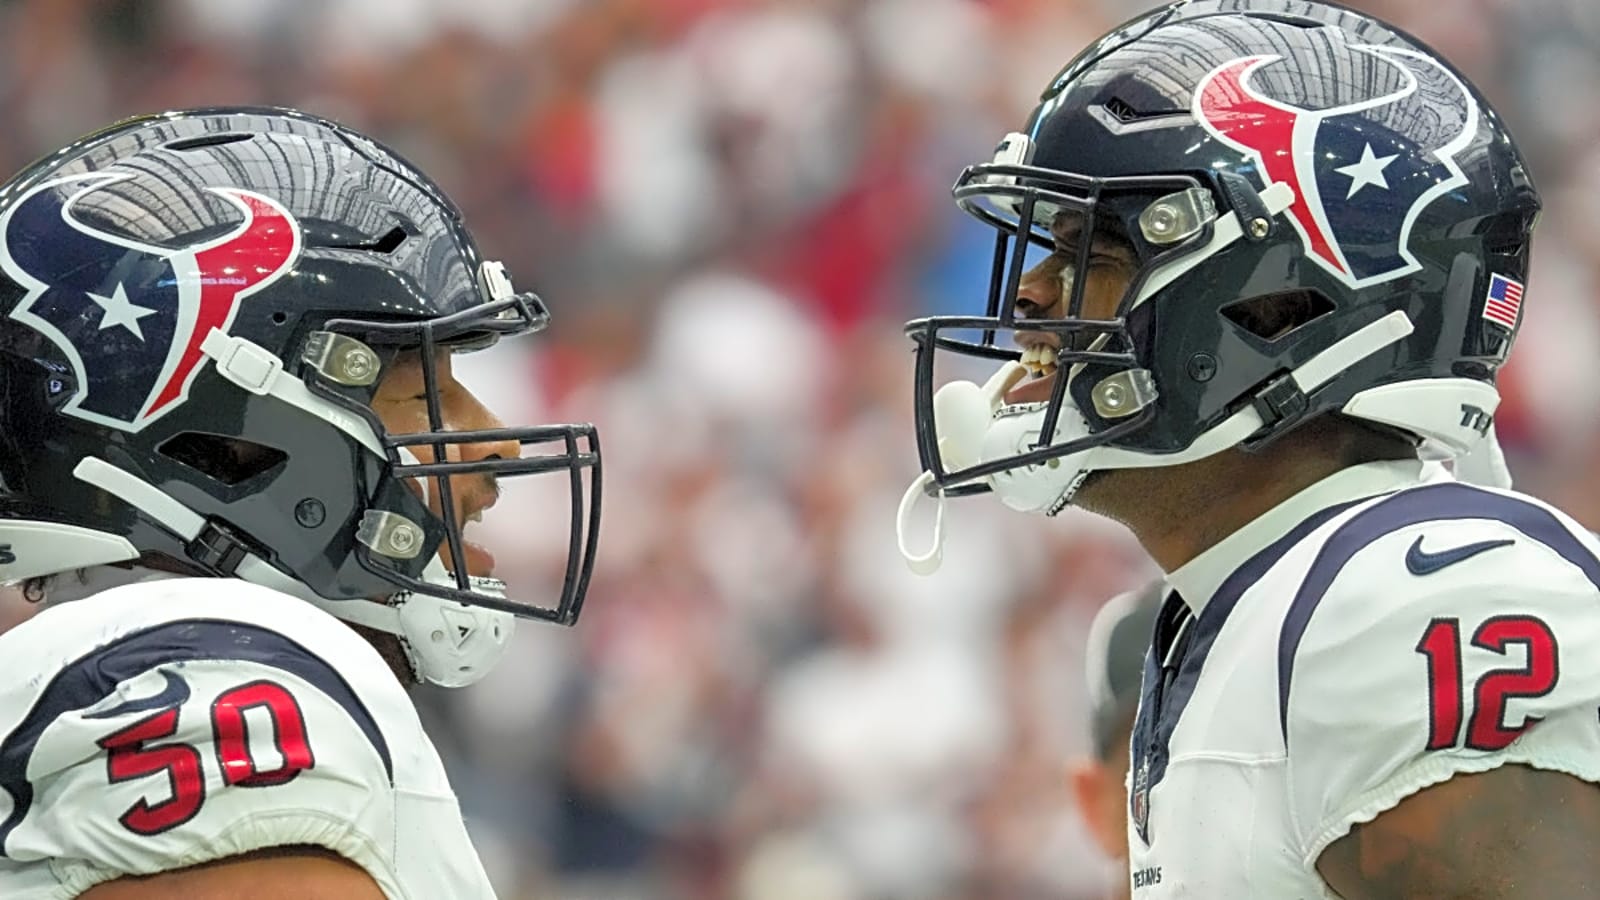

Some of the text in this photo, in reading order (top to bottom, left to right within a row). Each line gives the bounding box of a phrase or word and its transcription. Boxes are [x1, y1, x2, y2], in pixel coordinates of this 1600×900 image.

[1415, 614, 1559, 752] 12
[95, 679, 315, 836] 50
[1133, 866, 1162, 890] TEXANS
